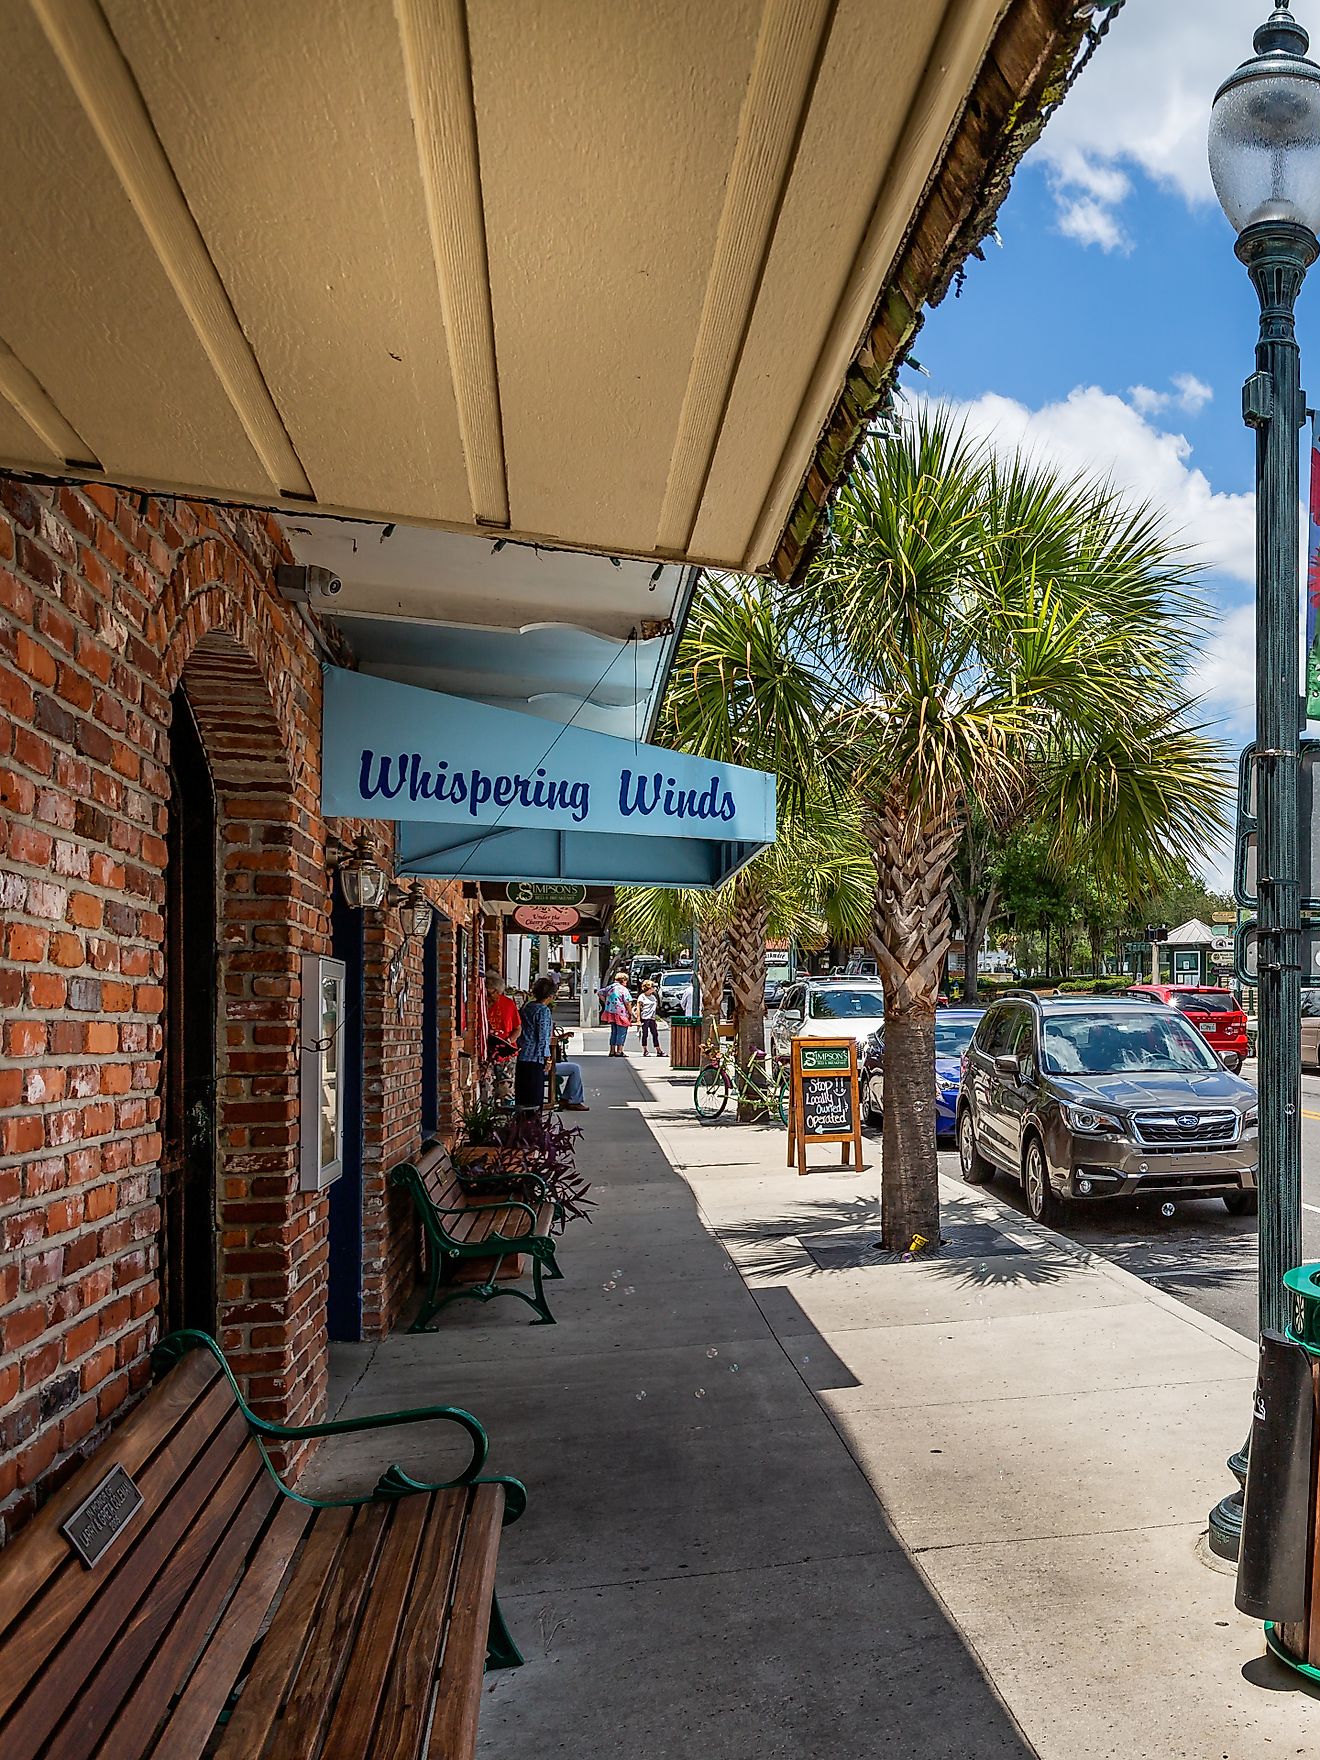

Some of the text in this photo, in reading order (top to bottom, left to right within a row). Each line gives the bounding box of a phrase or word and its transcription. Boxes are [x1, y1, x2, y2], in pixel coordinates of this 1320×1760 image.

[358, 749, 737, 822] Whispering Winds
[803, 1050, 848, 1067] SIMPSON'S
[809, 1078, 833, 1096] Stop
[806, 1093, 833, 1107] Locally
[816, 1098, 842, 1114] Owned
[807, 1109, 846, 1128] Operated
[80, 1522, 98, 1548] LARRY
